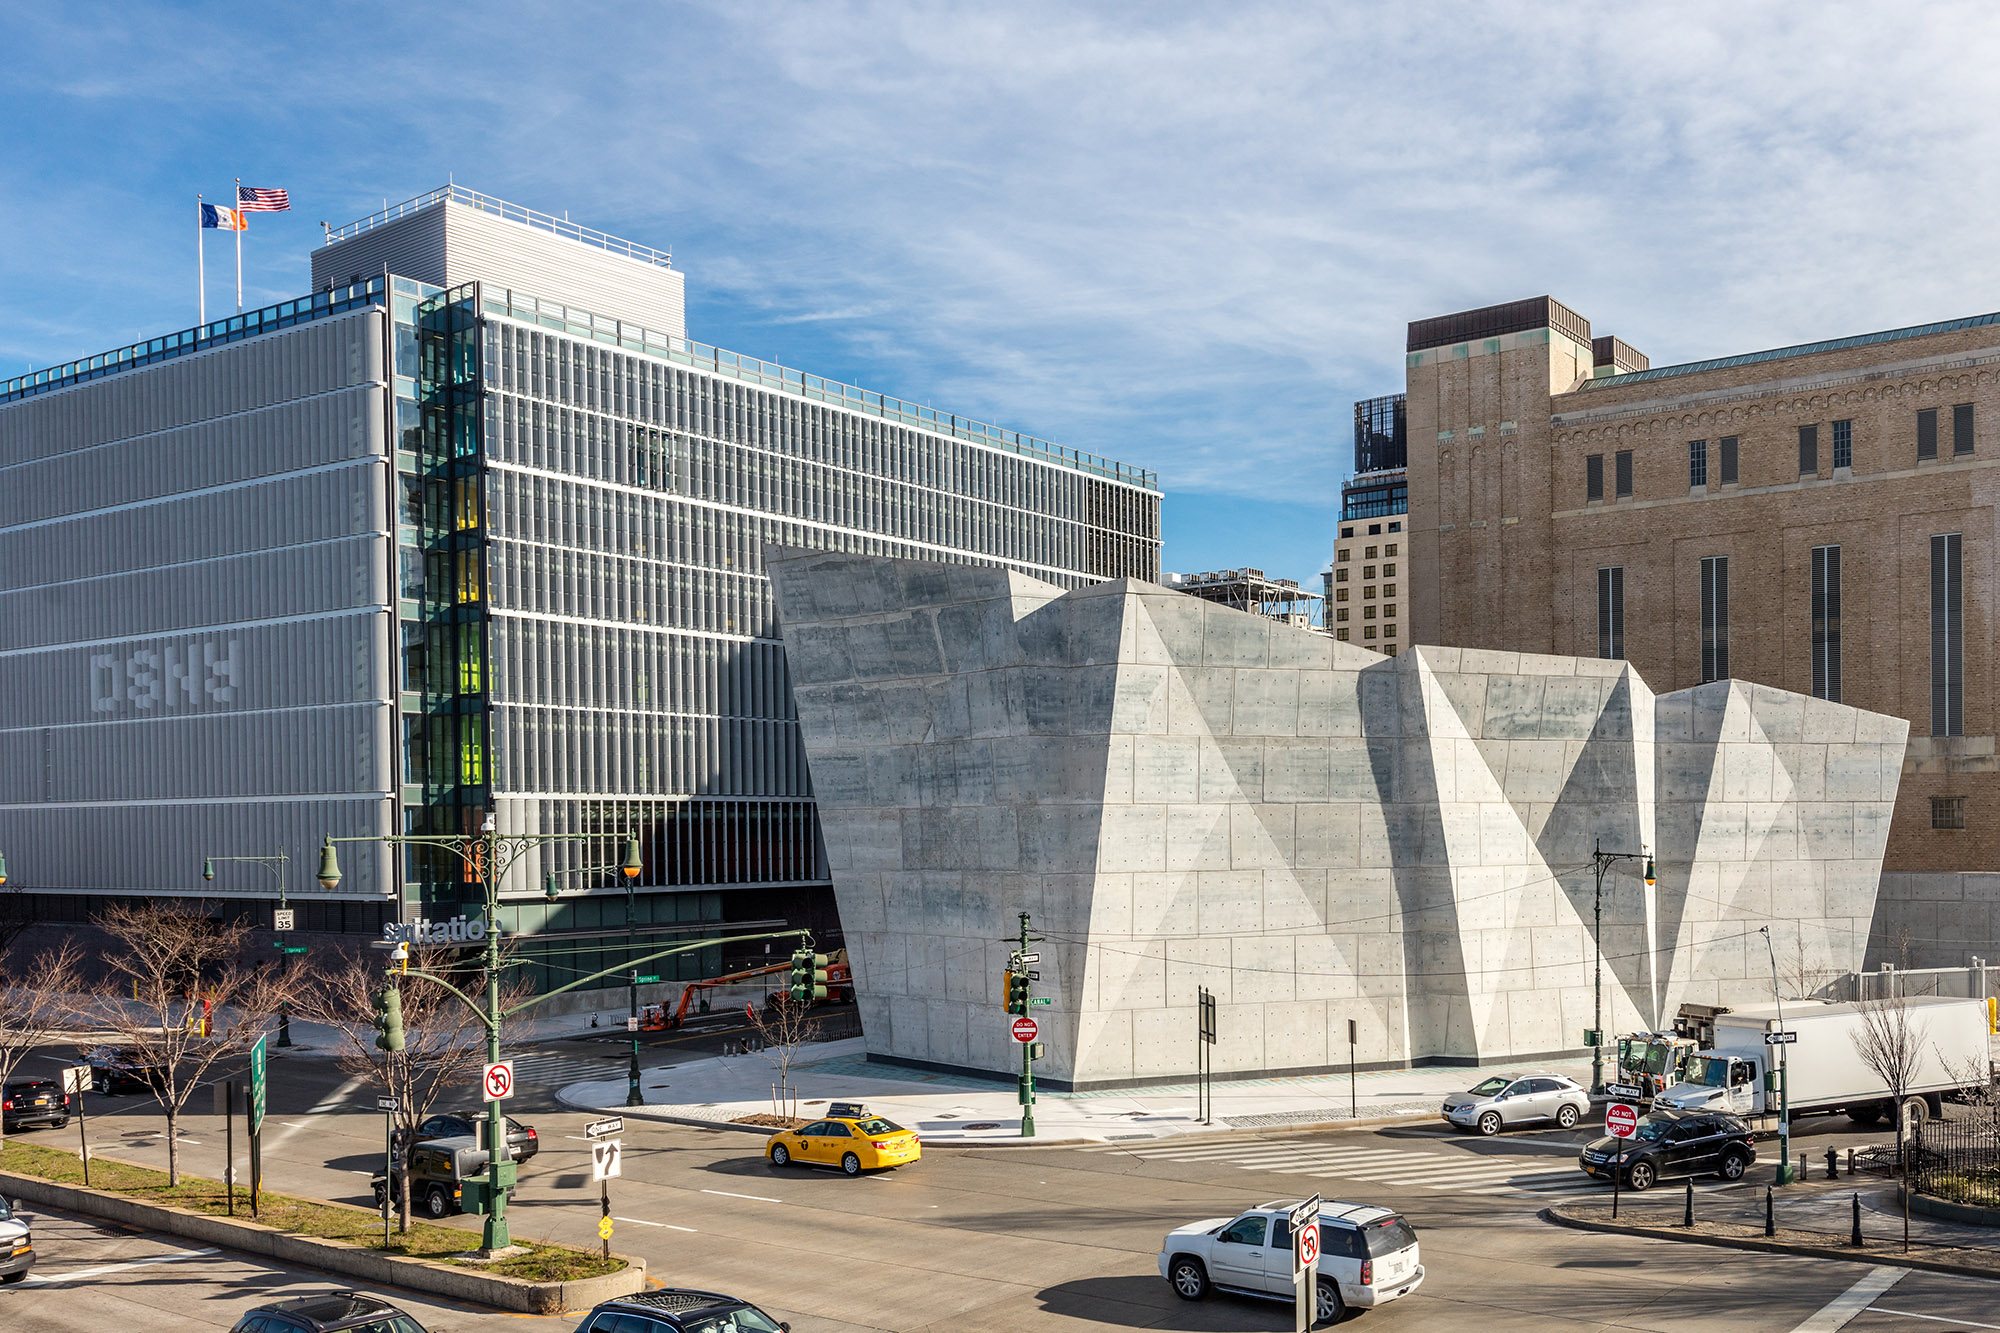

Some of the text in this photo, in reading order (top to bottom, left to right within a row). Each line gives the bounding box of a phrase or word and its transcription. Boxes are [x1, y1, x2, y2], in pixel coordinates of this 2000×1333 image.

[91, 640, 241, 713] DSNY
[278, 921, 291, 929] 35
[1031, 998, 1046, 1006] CANAL
[1612, 1124, 1630, 1132] ENTER
[1296, 1203, 1317, 1222] ONE WAY
